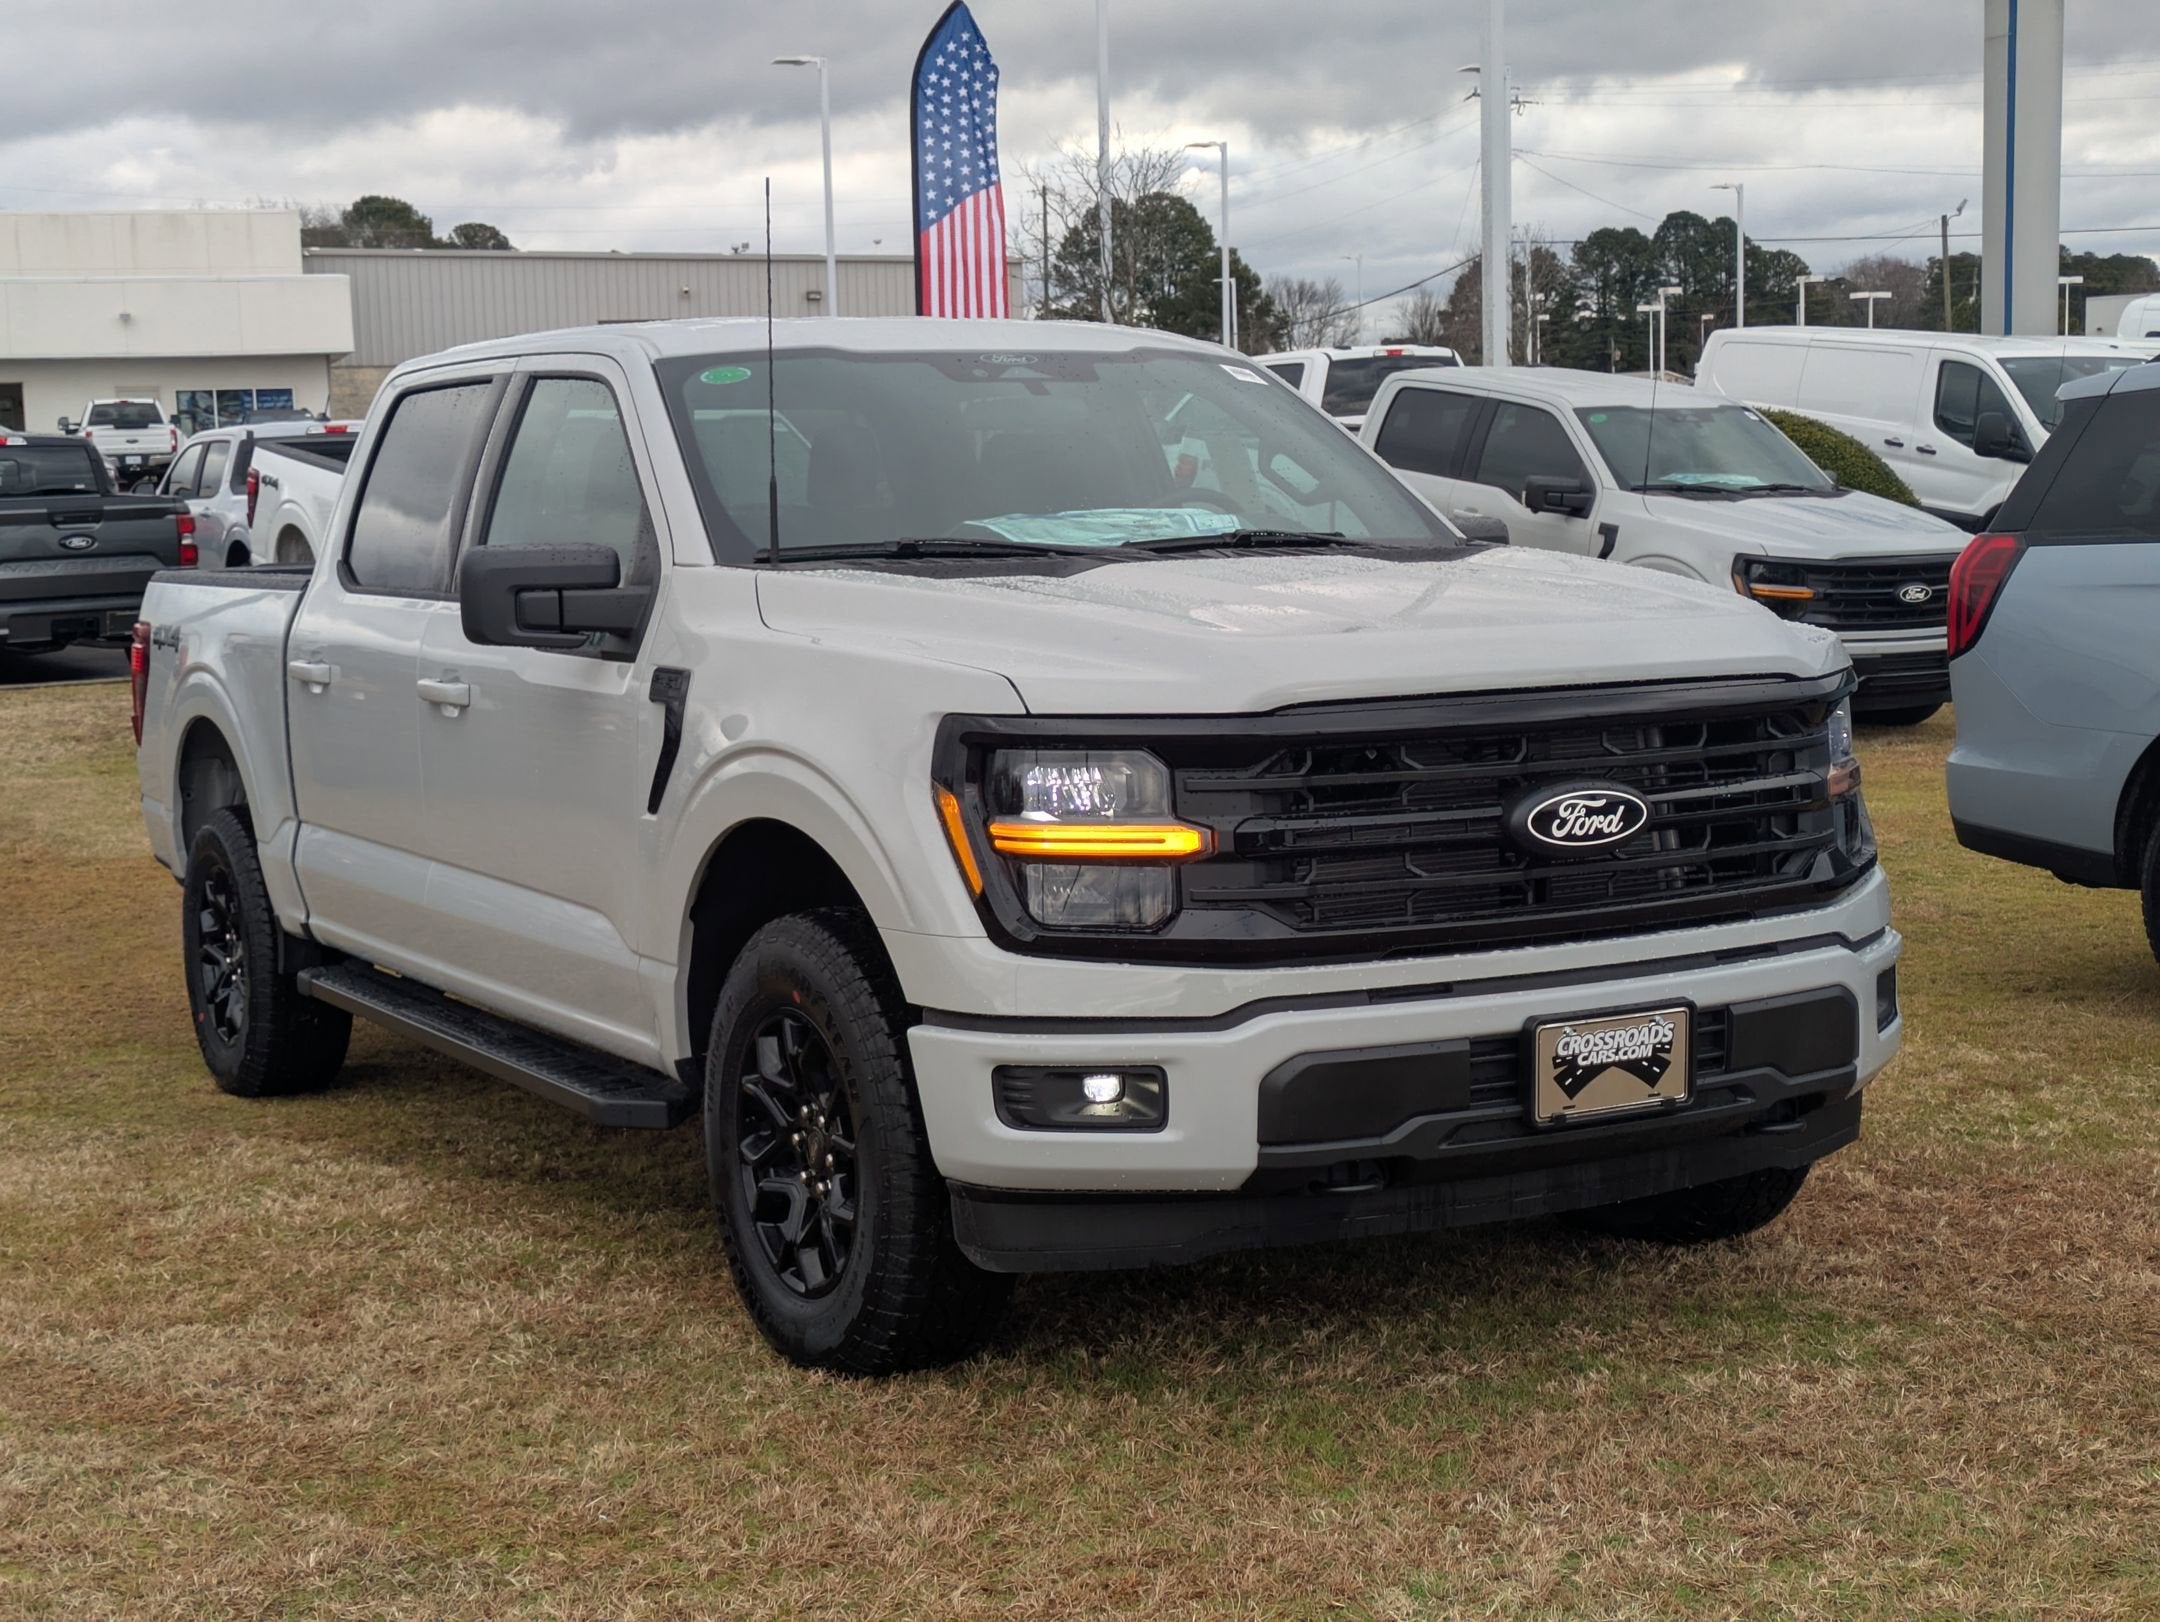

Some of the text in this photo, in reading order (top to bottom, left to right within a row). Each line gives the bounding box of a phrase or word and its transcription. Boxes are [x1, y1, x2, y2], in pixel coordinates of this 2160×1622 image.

[1551, 798, 1625, 838] Ford
[1556, 1021, 1676, 1057] CROSSROADS
[1576, 1043, 1653, 1067] CARS.COM
